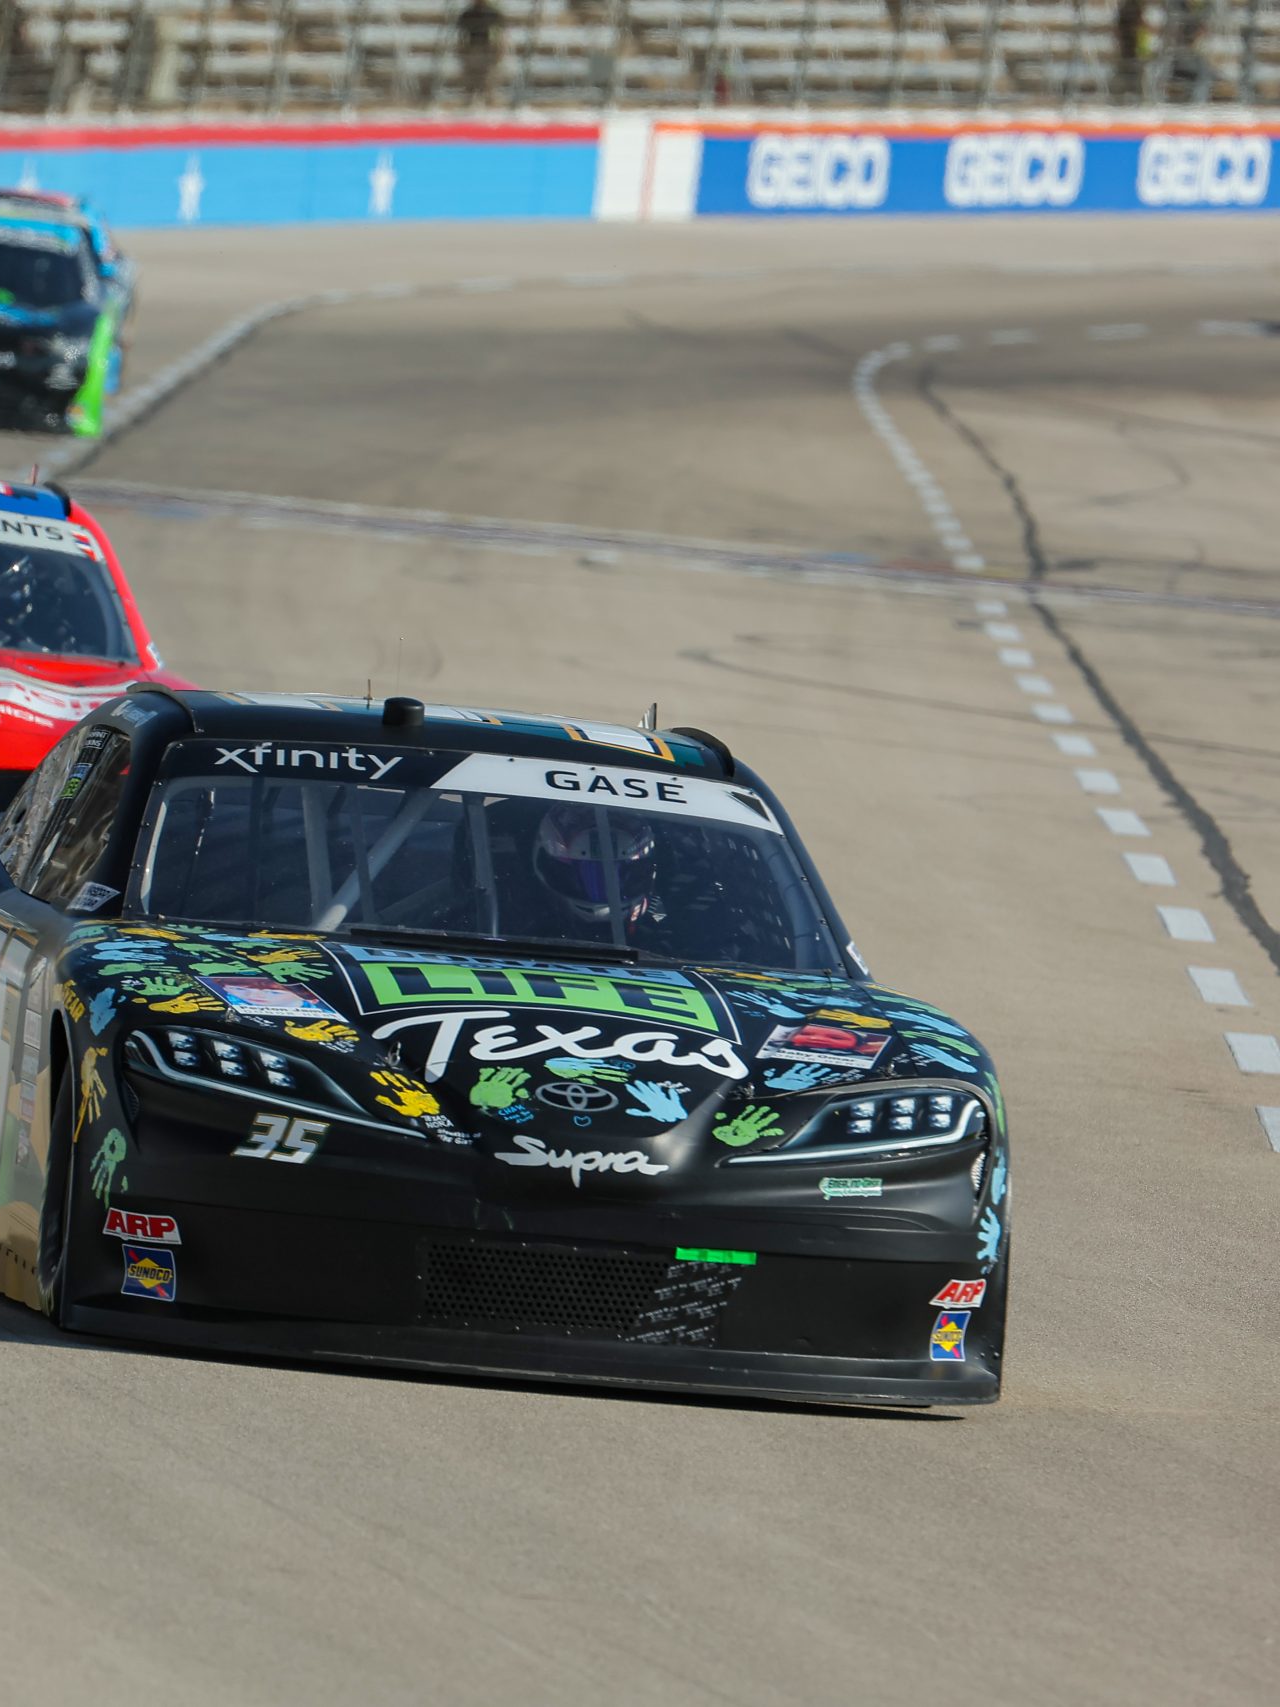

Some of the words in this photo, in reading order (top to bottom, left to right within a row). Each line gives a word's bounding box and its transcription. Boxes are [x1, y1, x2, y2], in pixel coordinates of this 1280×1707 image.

[747, 134, 890, 208] GEICO
[944, 133, 1084, 207] GEICO
[1138, 132, 1272, 206] GEICO
[215, 742, 403, 778] xfinity
[545, 769, 688, 804] GASE
[387, 966, 698, 1020] LIFE
[372, 1010, 749, 1083] Texas
[231, 1112, 330, 1164] 35
[495, 1135, 669, 1187] Supra
[107, 1210, 175, 1239] ARP
[129, 1265, 171, 1282] SUNOCO
[936, 1281, 985, 1303] ARP
